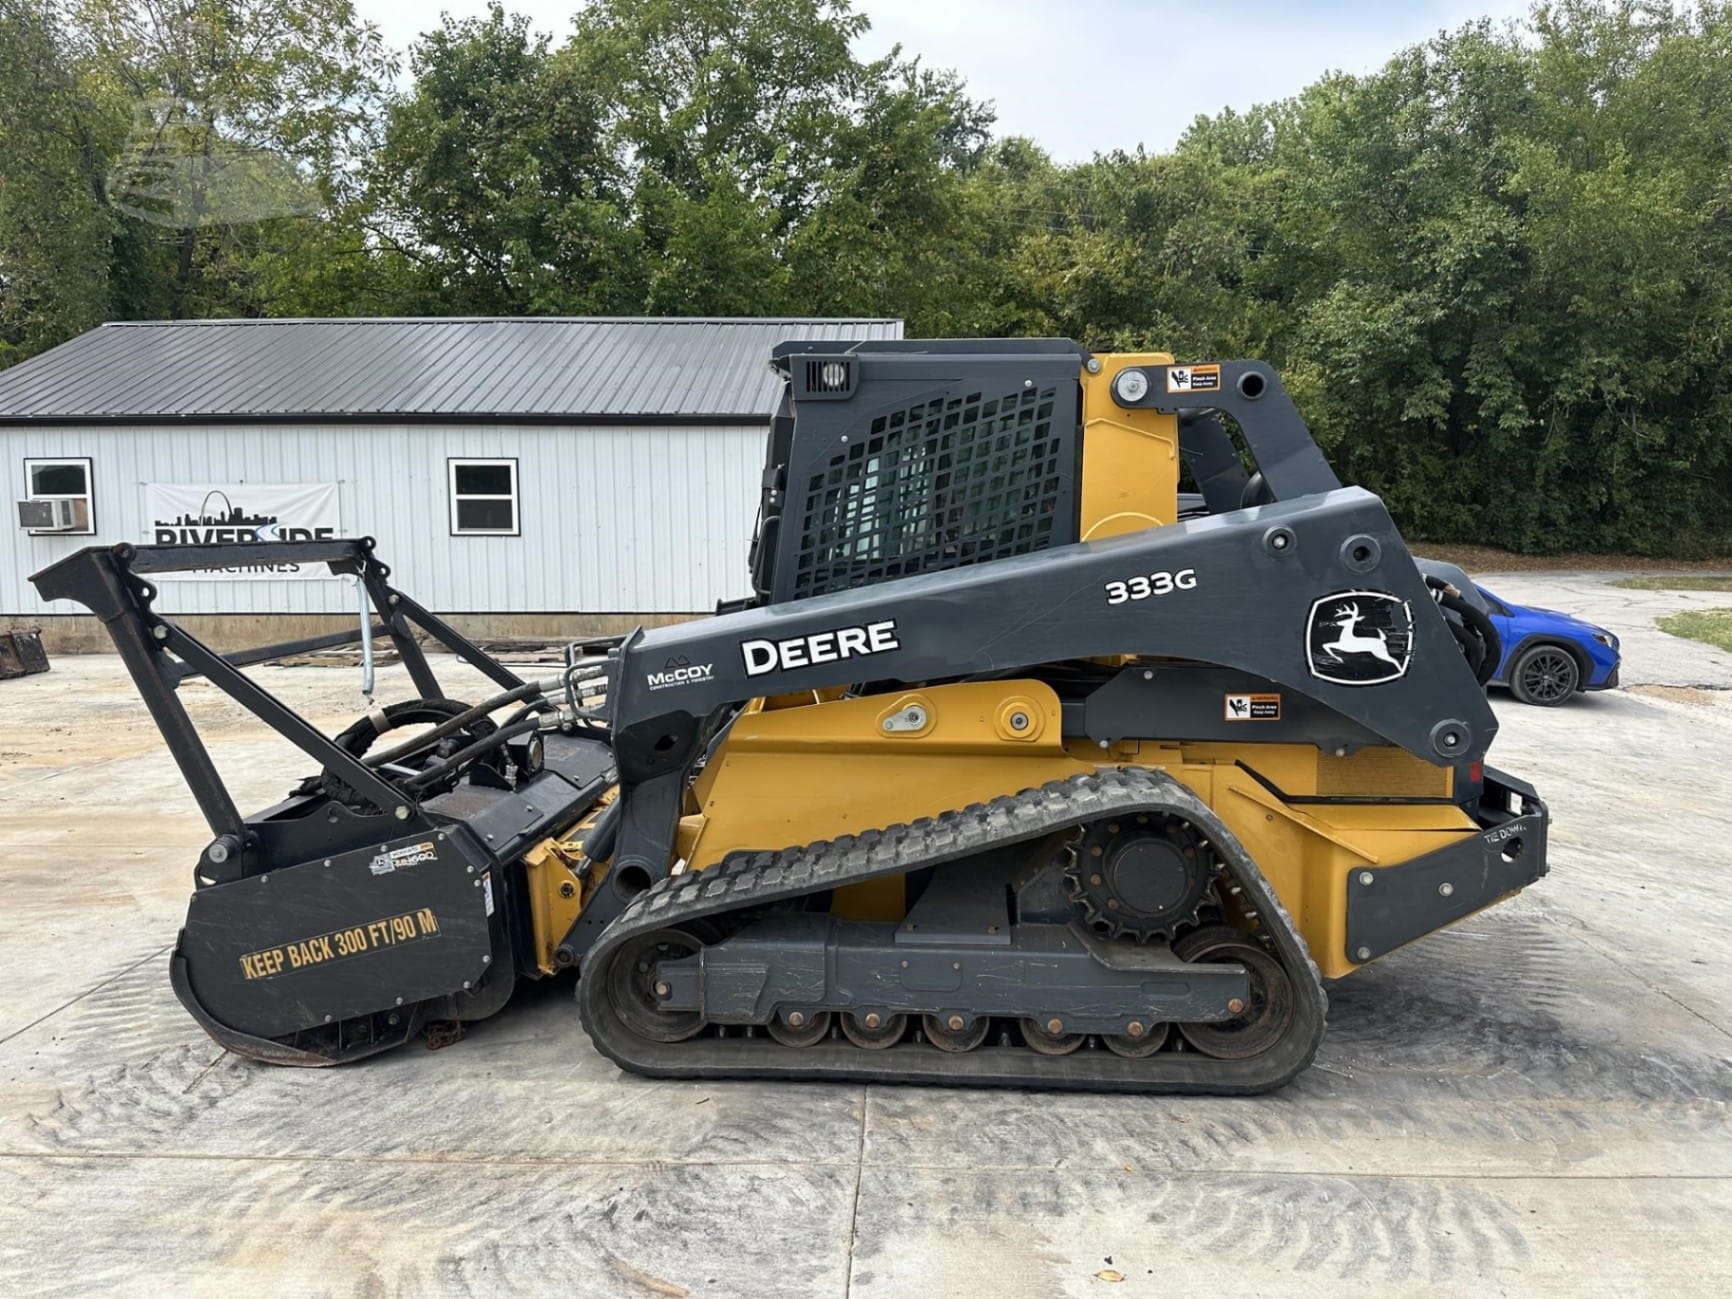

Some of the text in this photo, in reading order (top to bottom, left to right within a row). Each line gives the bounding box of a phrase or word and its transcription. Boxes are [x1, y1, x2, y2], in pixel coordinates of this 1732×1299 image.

[192, 562, 301, 574] CHINES
[1104, 568, 1198, 605] 333G
[741, 619, 900, 677] DEERE
[647, 663, 713, 686] McCOY
[242, 909, 438, 979] KEEP BACK 300 FT/90 M
